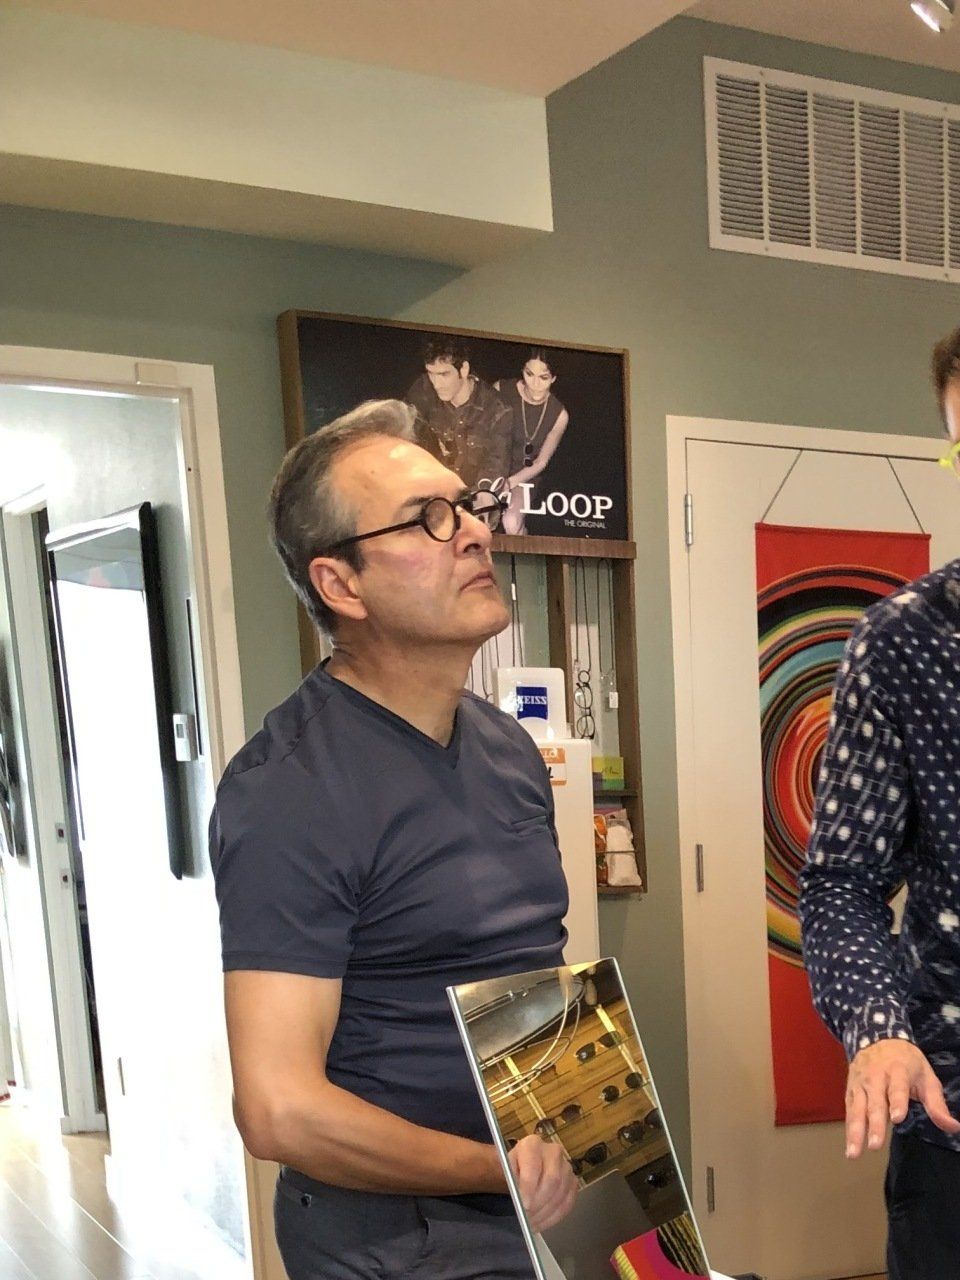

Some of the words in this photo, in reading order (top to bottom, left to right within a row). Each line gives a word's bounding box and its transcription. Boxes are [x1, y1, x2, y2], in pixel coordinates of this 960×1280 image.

[518, 482, 613, 519] LOOP
[564, 519, 575, 527] THE
[576, 520, 606, 529] ORIGINAL
